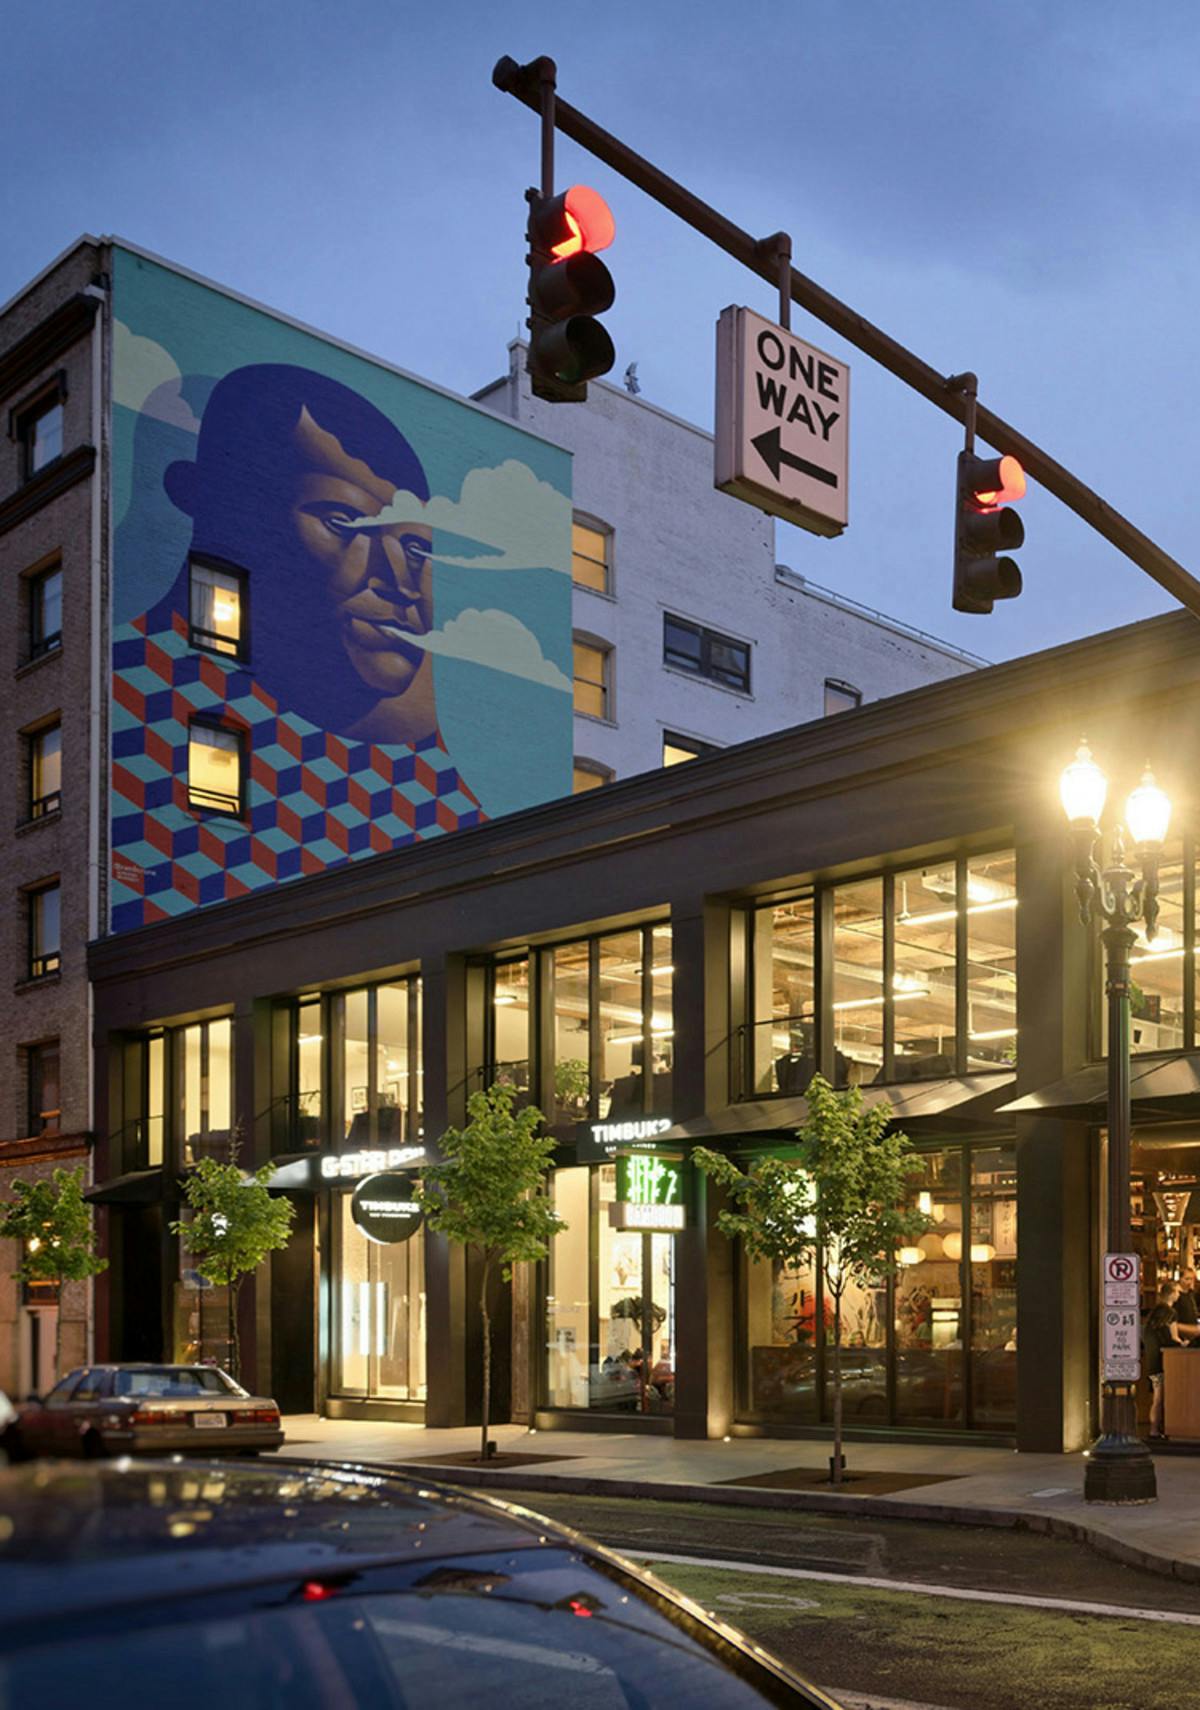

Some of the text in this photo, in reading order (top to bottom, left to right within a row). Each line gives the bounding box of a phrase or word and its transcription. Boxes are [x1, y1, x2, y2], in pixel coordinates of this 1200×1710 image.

[757, 330, 839, 402] ONE
[756, 371, 840, 442] WAY
[591, 1119, 672, 1143] TIMBUK2
